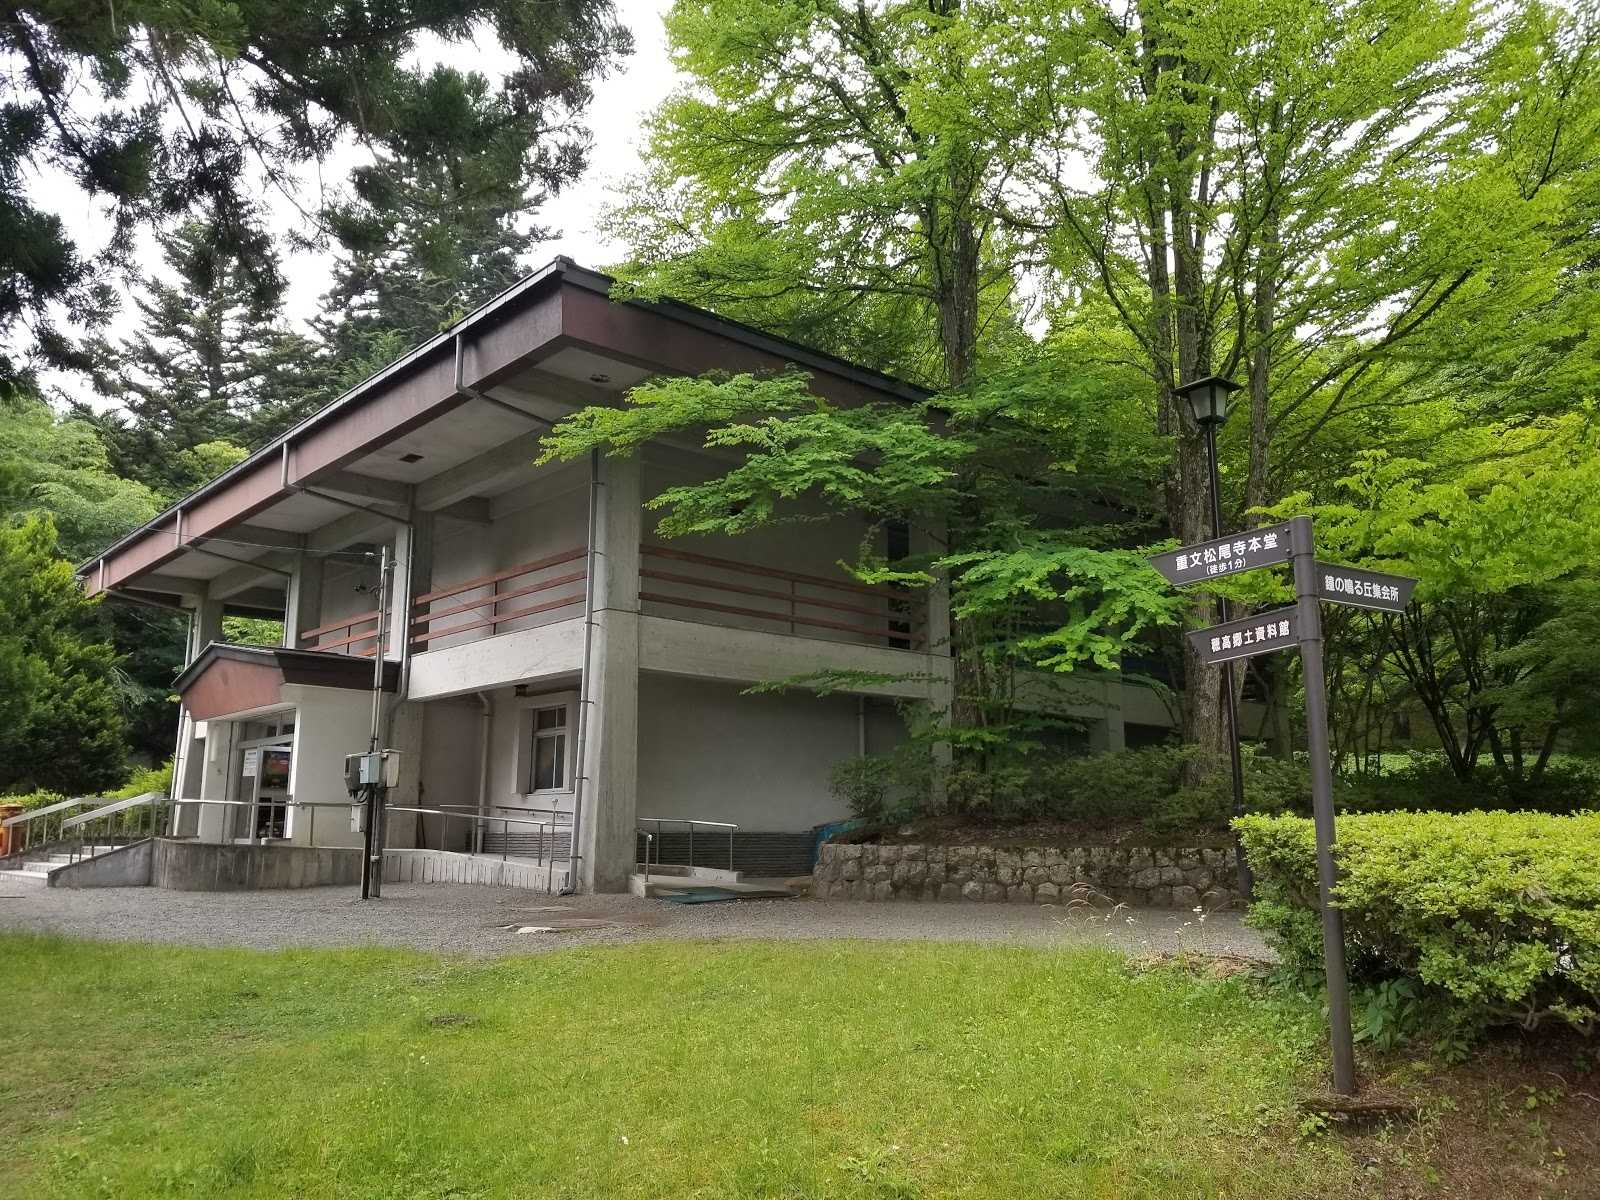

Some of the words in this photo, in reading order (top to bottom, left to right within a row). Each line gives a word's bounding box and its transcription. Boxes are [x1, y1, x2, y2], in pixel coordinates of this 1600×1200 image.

[1175, 532, 1279, 571] 重文松尾寺本堂
[1324, 574, 1399, 602] 鐘の鳴る丘集会所
[1210, 619, 1290, 653] 穂高郷土資料館
